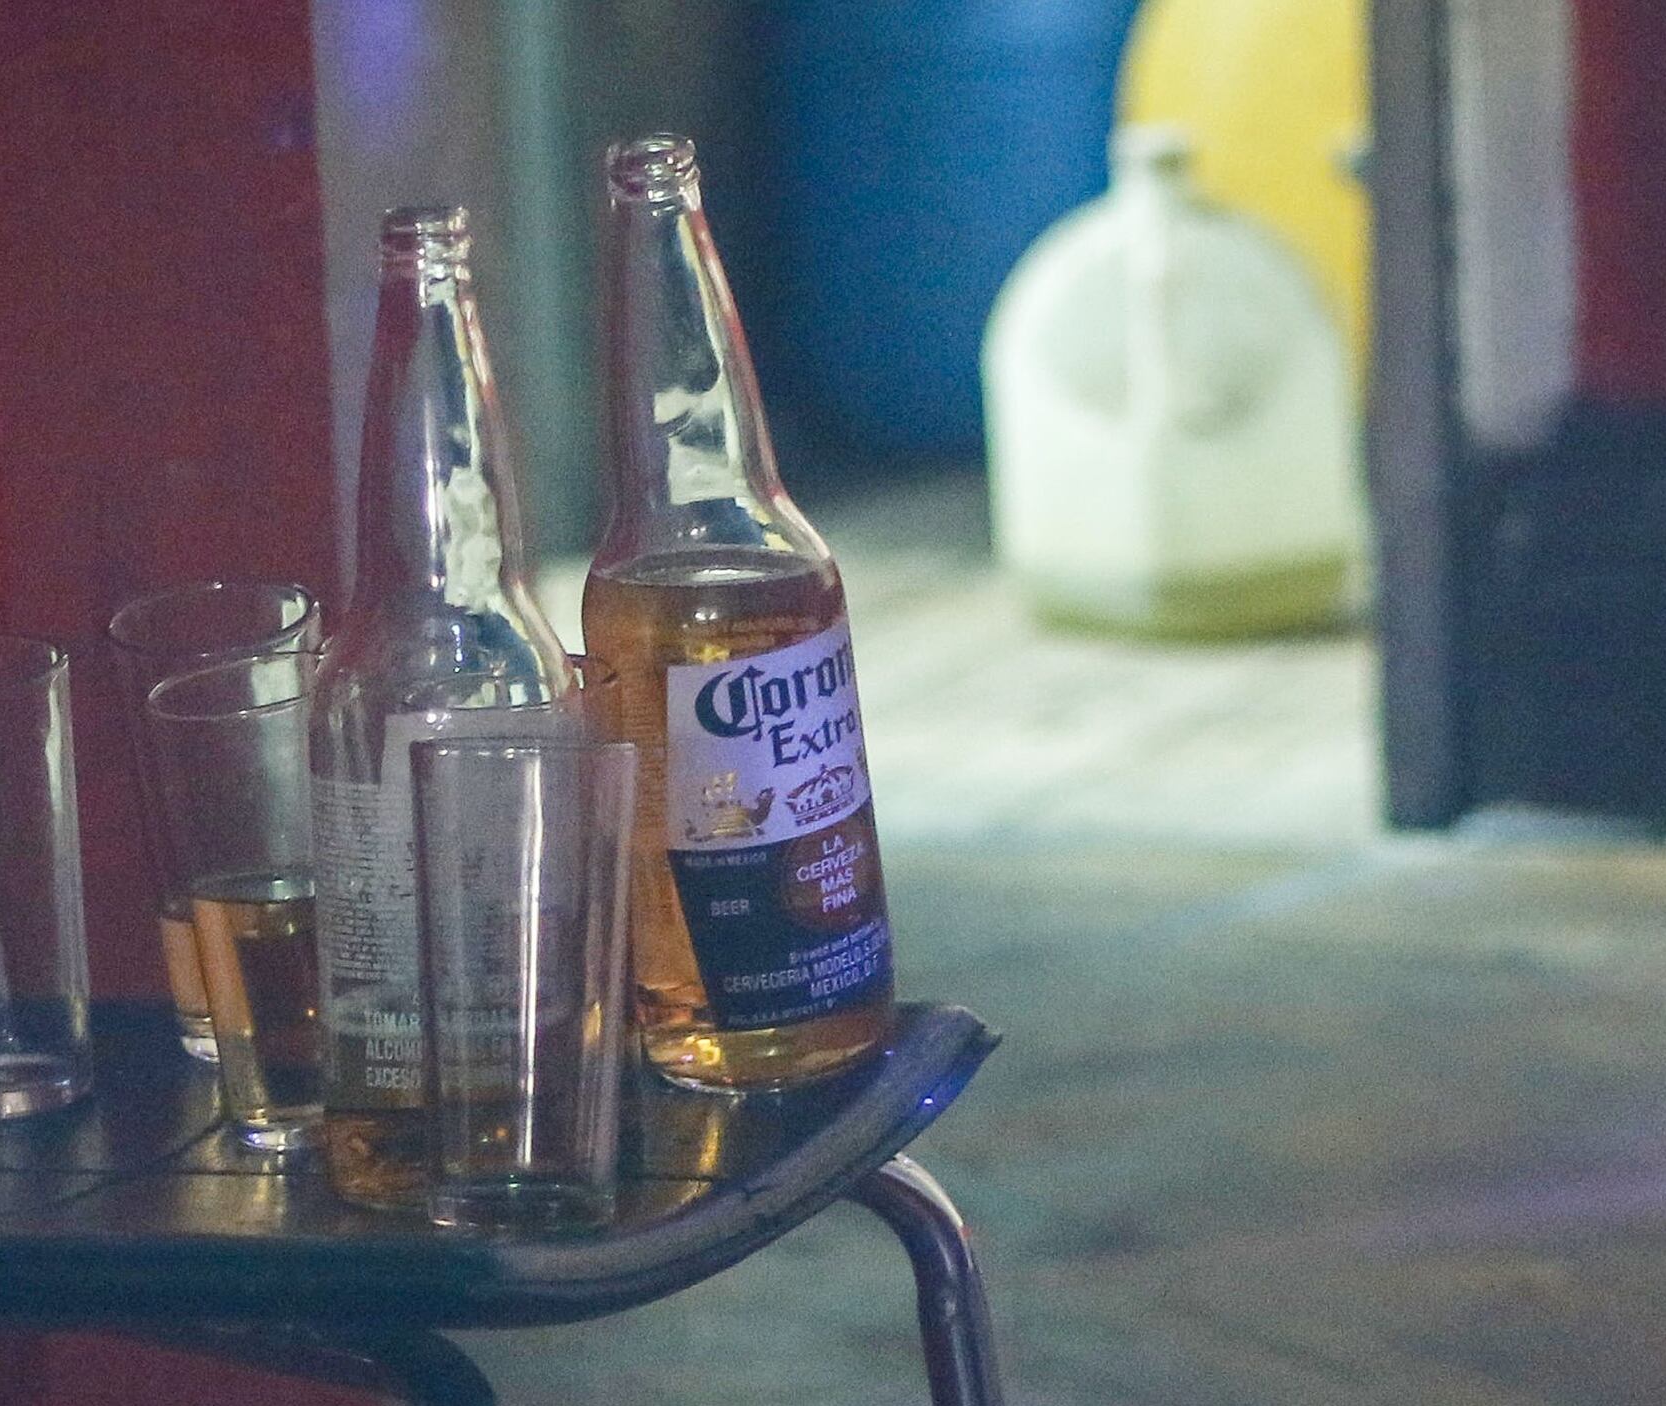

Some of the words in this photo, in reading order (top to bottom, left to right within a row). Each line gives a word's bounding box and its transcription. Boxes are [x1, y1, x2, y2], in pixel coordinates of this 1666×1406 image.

[694, 642, 855, 742] Coron
[822, 834, 844, 855] LA
[820, 866, 855, 894] MAS
[710, 899, 751, 917] BEER
[822, 884, 858, 914] FINA
[363, 1008, 422, 1032] TOMAR
[365, 1066, 422, 1090] EXCESO
